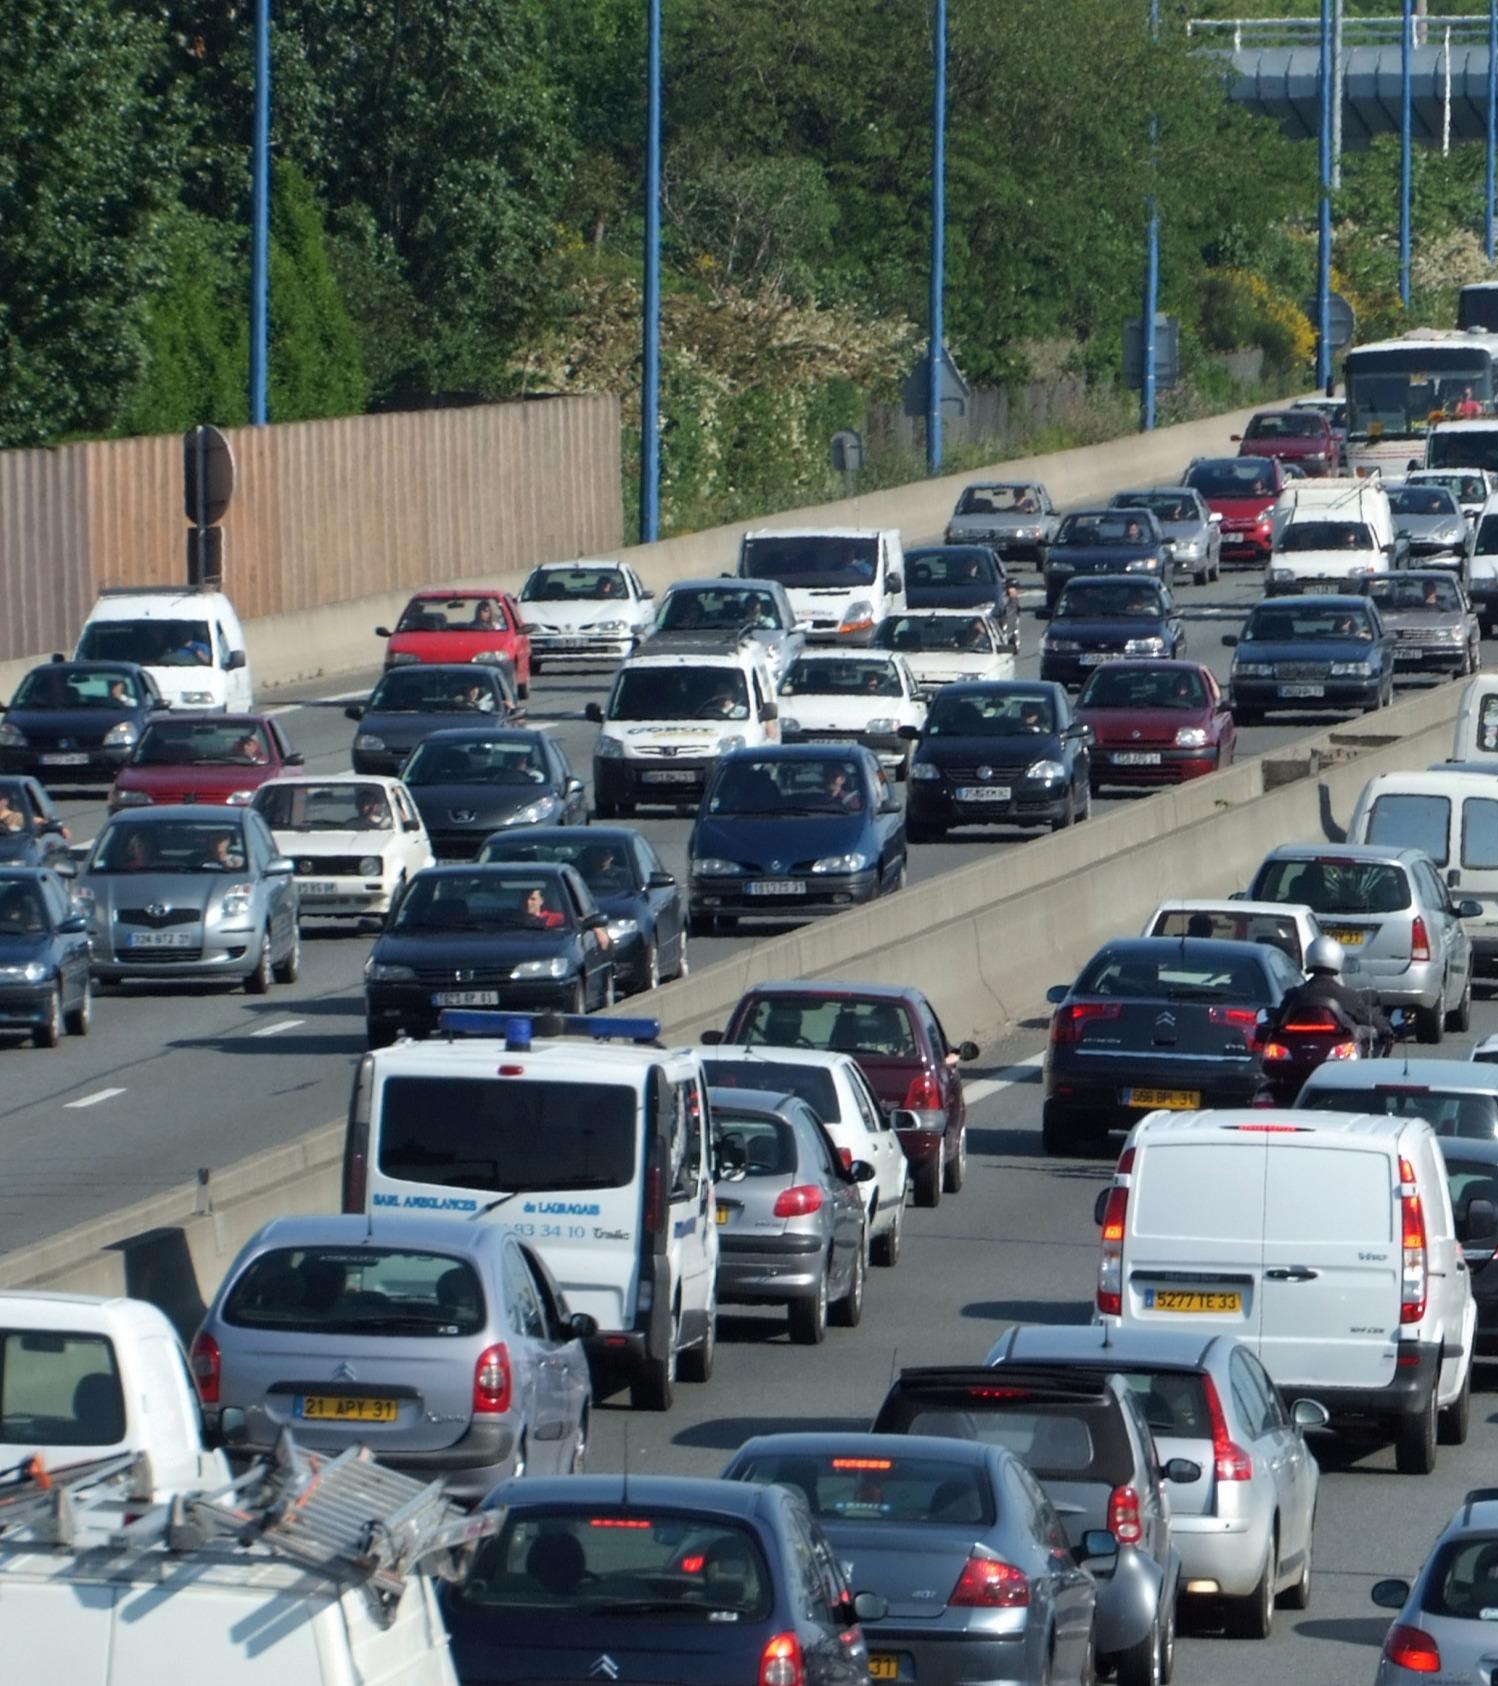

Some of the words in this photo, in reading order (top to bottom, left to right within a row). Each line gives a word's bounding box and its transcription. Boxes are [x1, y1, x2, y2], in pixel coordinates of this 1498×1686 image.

[540, 1224, 561, 1238] 34
[569, 1226, 585, 1239] 10
[1156, 1291, 1195, 1308] 5277
[1197, 1292, 1215, 1309] TE
[1218, 1293, 1237, 1310] 33
[305, 1398, 323, 1415] 21
[335, 1399, 365, 1417] APY
[373, 1401, 392, 1418] 31
[869, 1657, 891, 1677] 31
